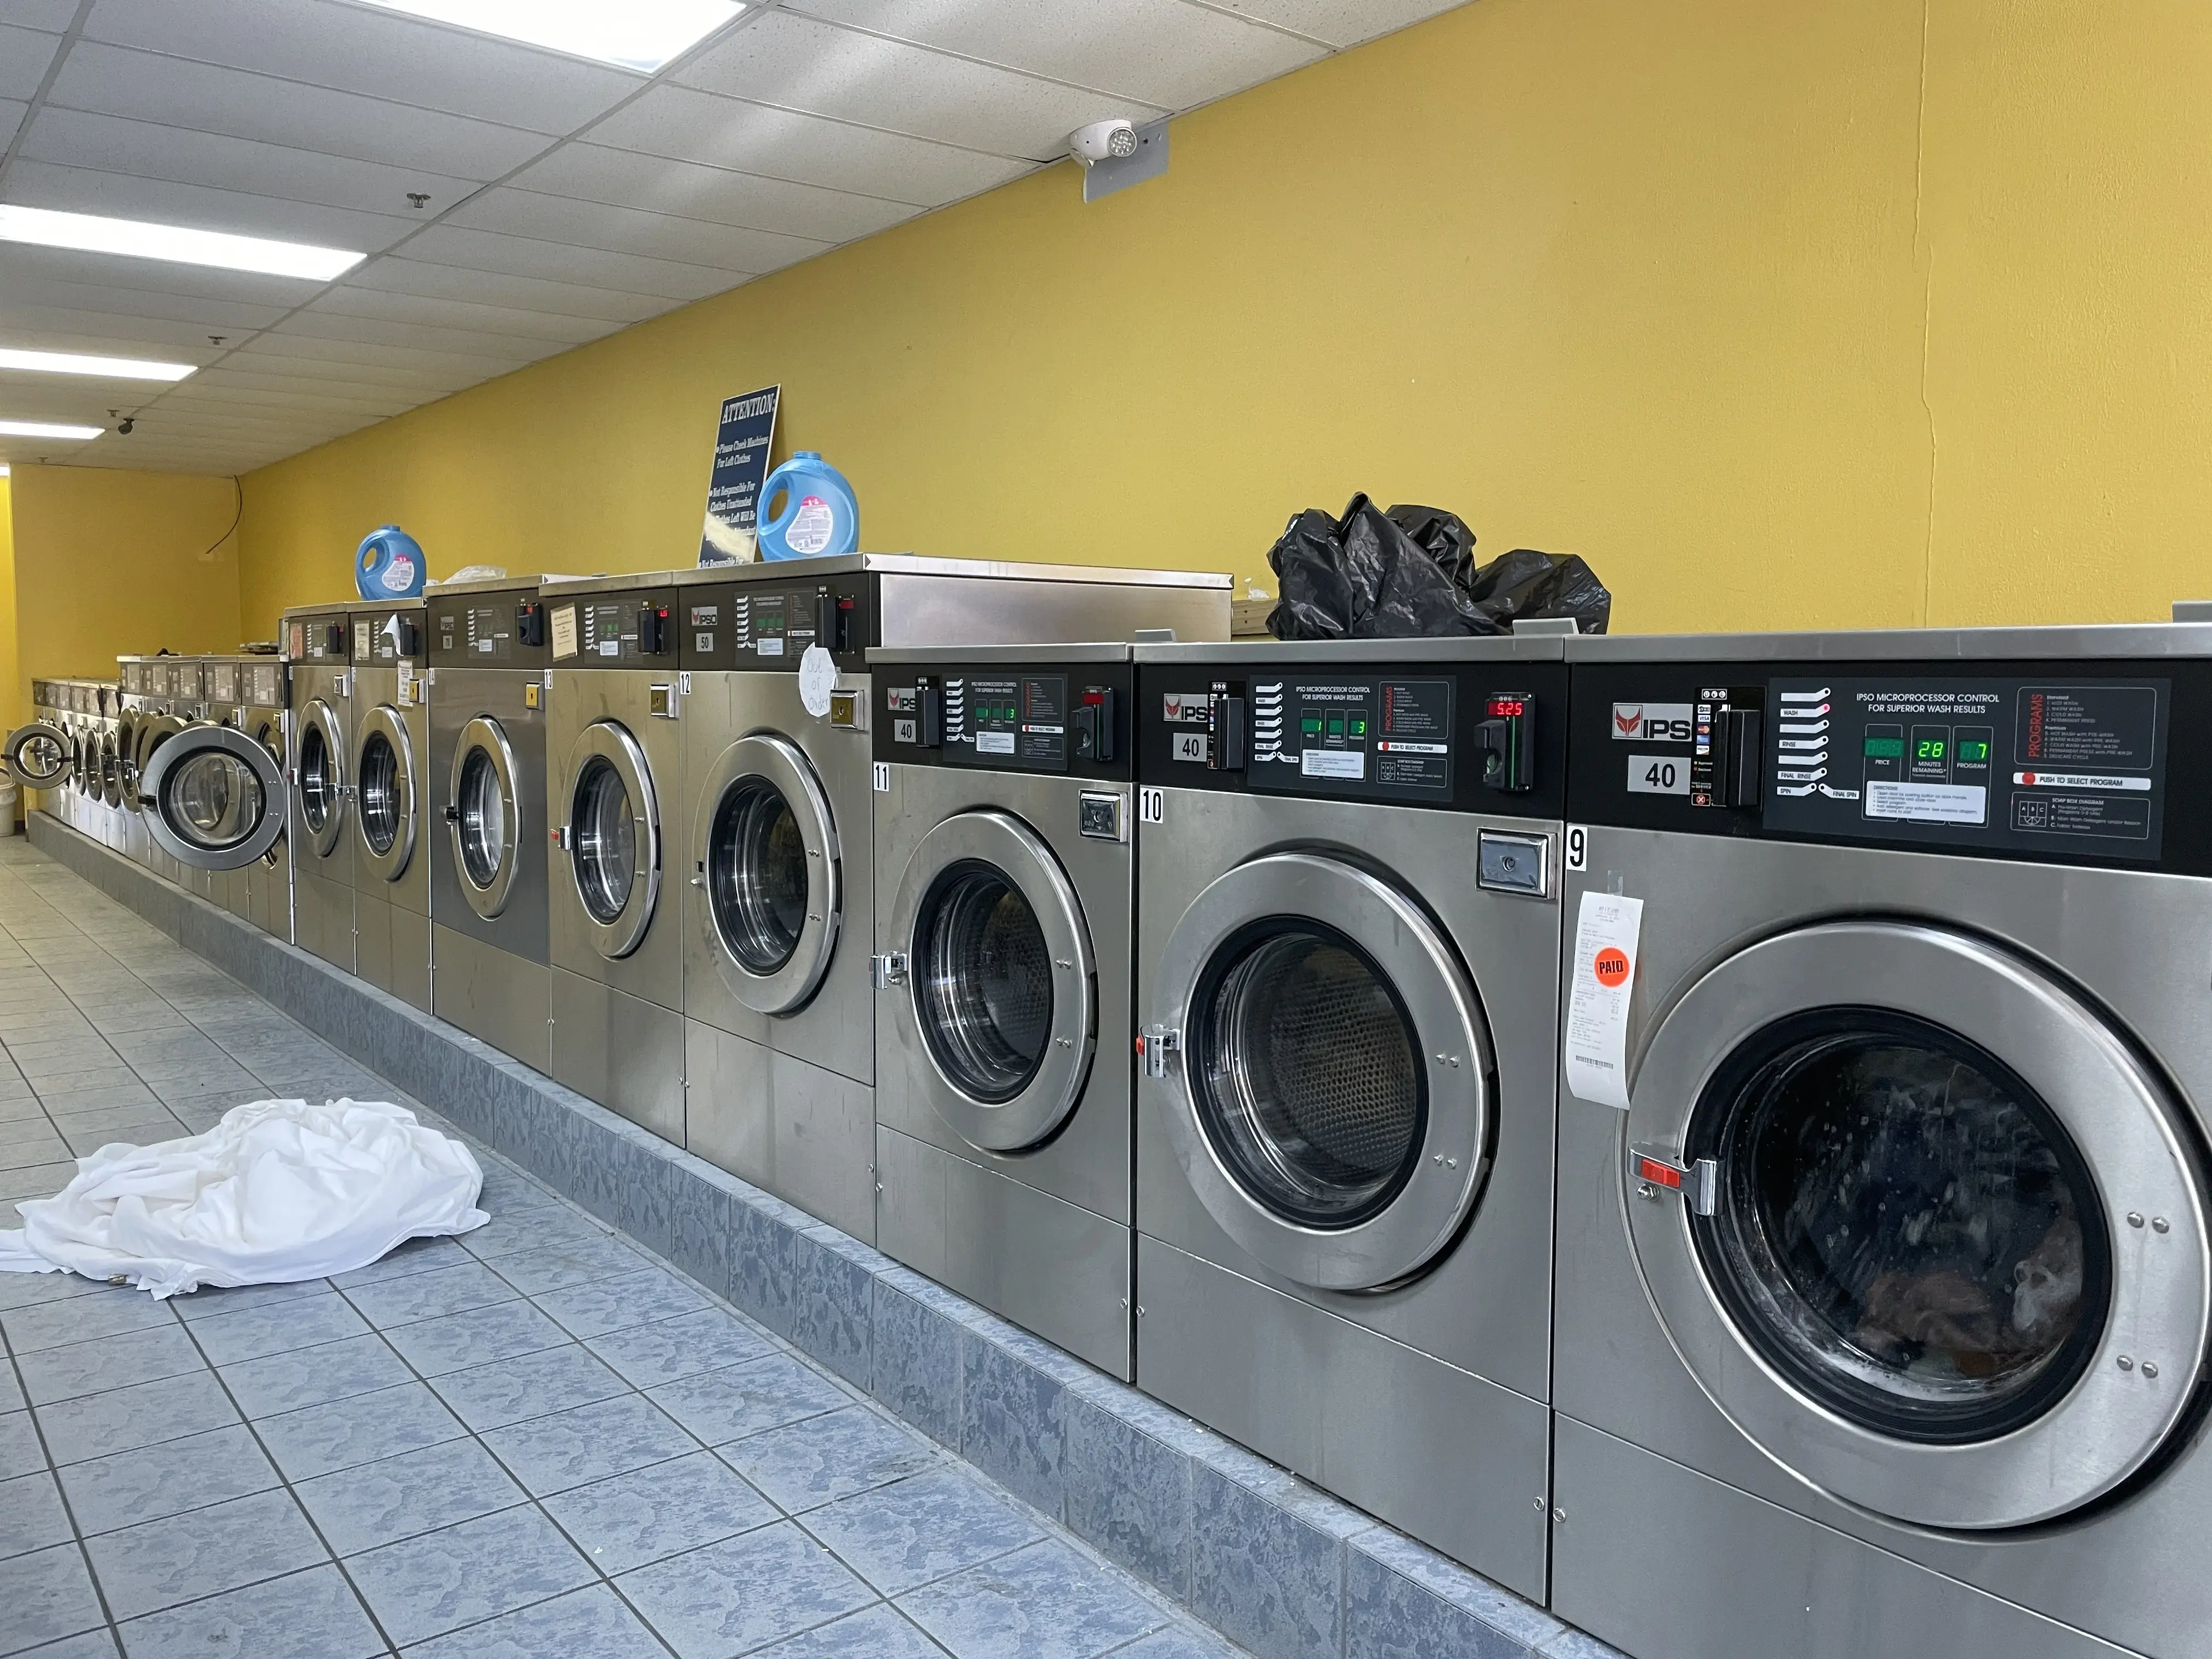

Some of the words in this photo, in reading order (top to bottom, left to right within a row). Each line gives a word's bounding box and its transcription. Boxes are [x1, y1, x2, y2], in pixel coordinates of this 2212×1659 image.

[721, 393, 776, 424] ATTENTION:
[719, 444, 733, 454] Please
[716, 459, 725, 469] For
[734, 453, 751, 465] Clothes
[699, 614, 716, 624] IPSO
[701, 636, 709, 648] 50
[807, 657, 823, 673] Out
[546, 672, 551, 687] 13
[681, 674, 690, 693] 12
[812, 676, 820, 691] of
[809, 694, 828, 709] Order
[900, 698, 916, 709] IPS
[1876, 693, 1955, 702] MICROPROCESSOR
[1957, 694, 1999, 702] CONTROL
[1010, 709, 1014, 718] 3
[1181, 706, 1207, 721] IPS
[1887, 704, 1925, 713] SUPERIOR
[1927, 705, 1951, 713] WASH
[1954, 706, 1985, 714] RESULTS
[901, 724, 912, 738] 40
[1358, 721, 1365, 733] 3
[1643, 719, 1691, 740] IPS
[2028, 693, 2043, 758] PROGRAMS
[1182, 738, 1199, 757] 40
[1918, 742, 1944, 758] 28
[1978, 743, 1987, 759] 7
[876, 765, 887, 790] 11
[1645, 763, 1675, 788] 40
[1143, 790, 1161, 821] 10
[1570, 829, 1584, 867] 9
[1599, 960, 1624, 974] PAID
